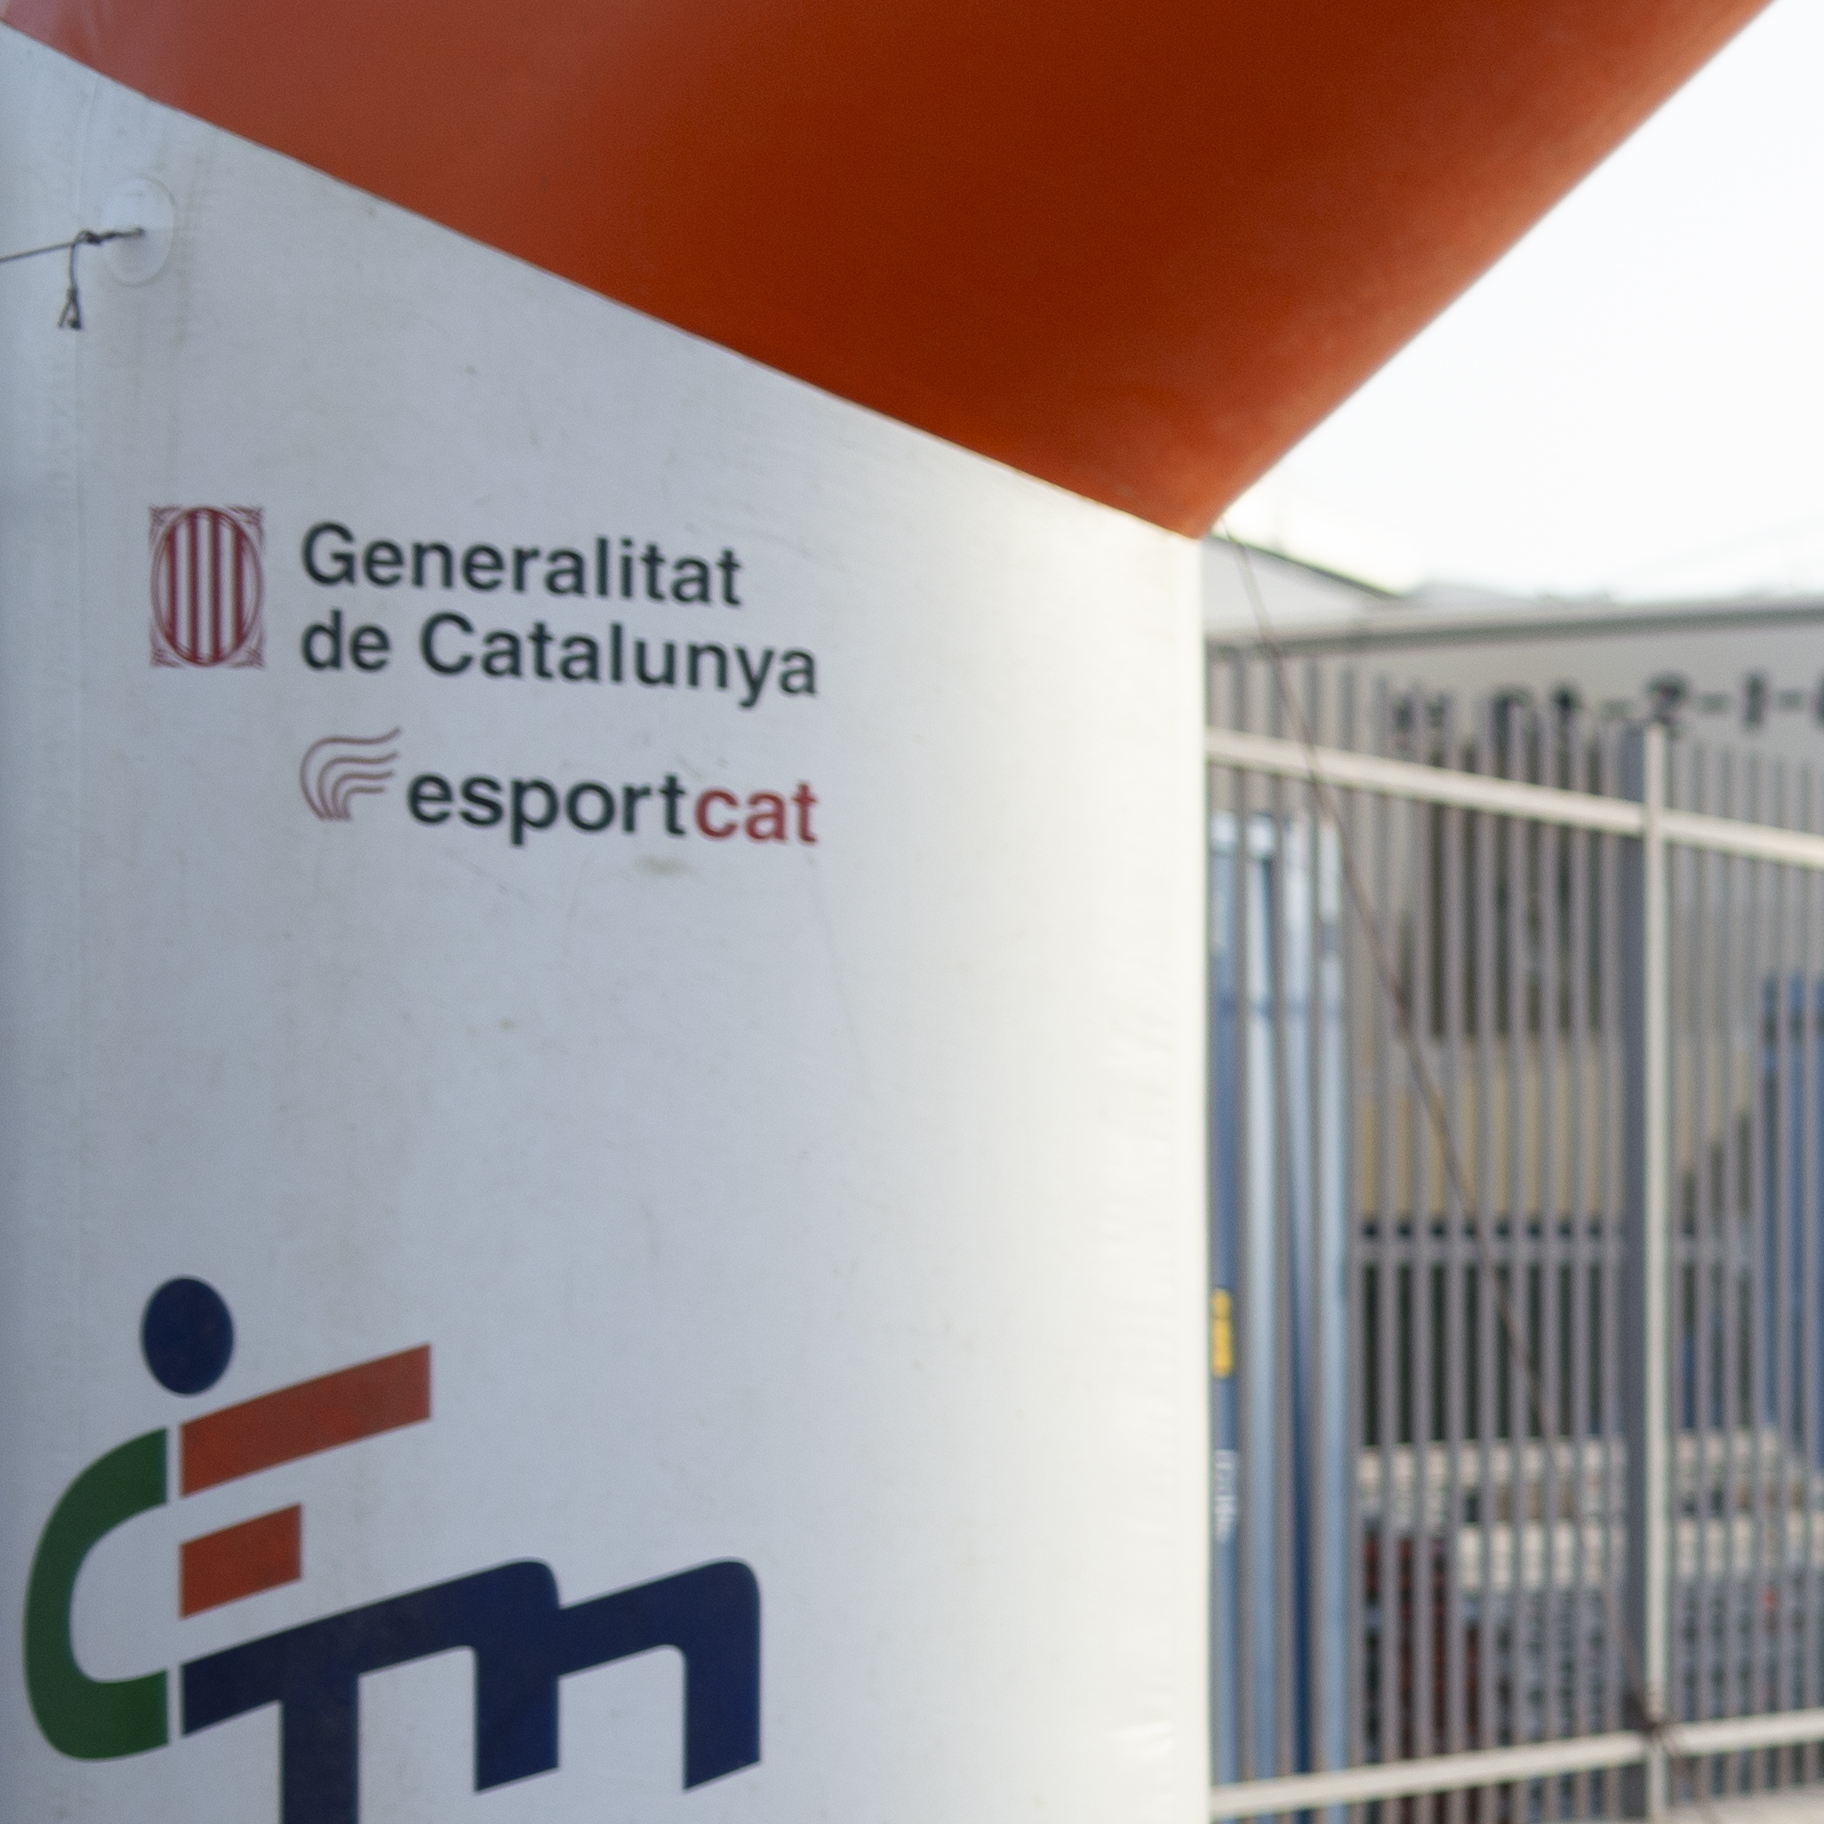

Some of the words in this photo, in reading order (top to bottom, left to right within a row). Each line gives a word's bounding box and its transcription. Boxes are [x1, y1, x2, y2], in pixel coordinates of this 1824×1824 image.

[301, 521, 742, 606] Generalitat
[301, 609, 391, 671] de
[420, 612, 819, 708] Catalunya
[406, 771, 819, 847] esportcat
